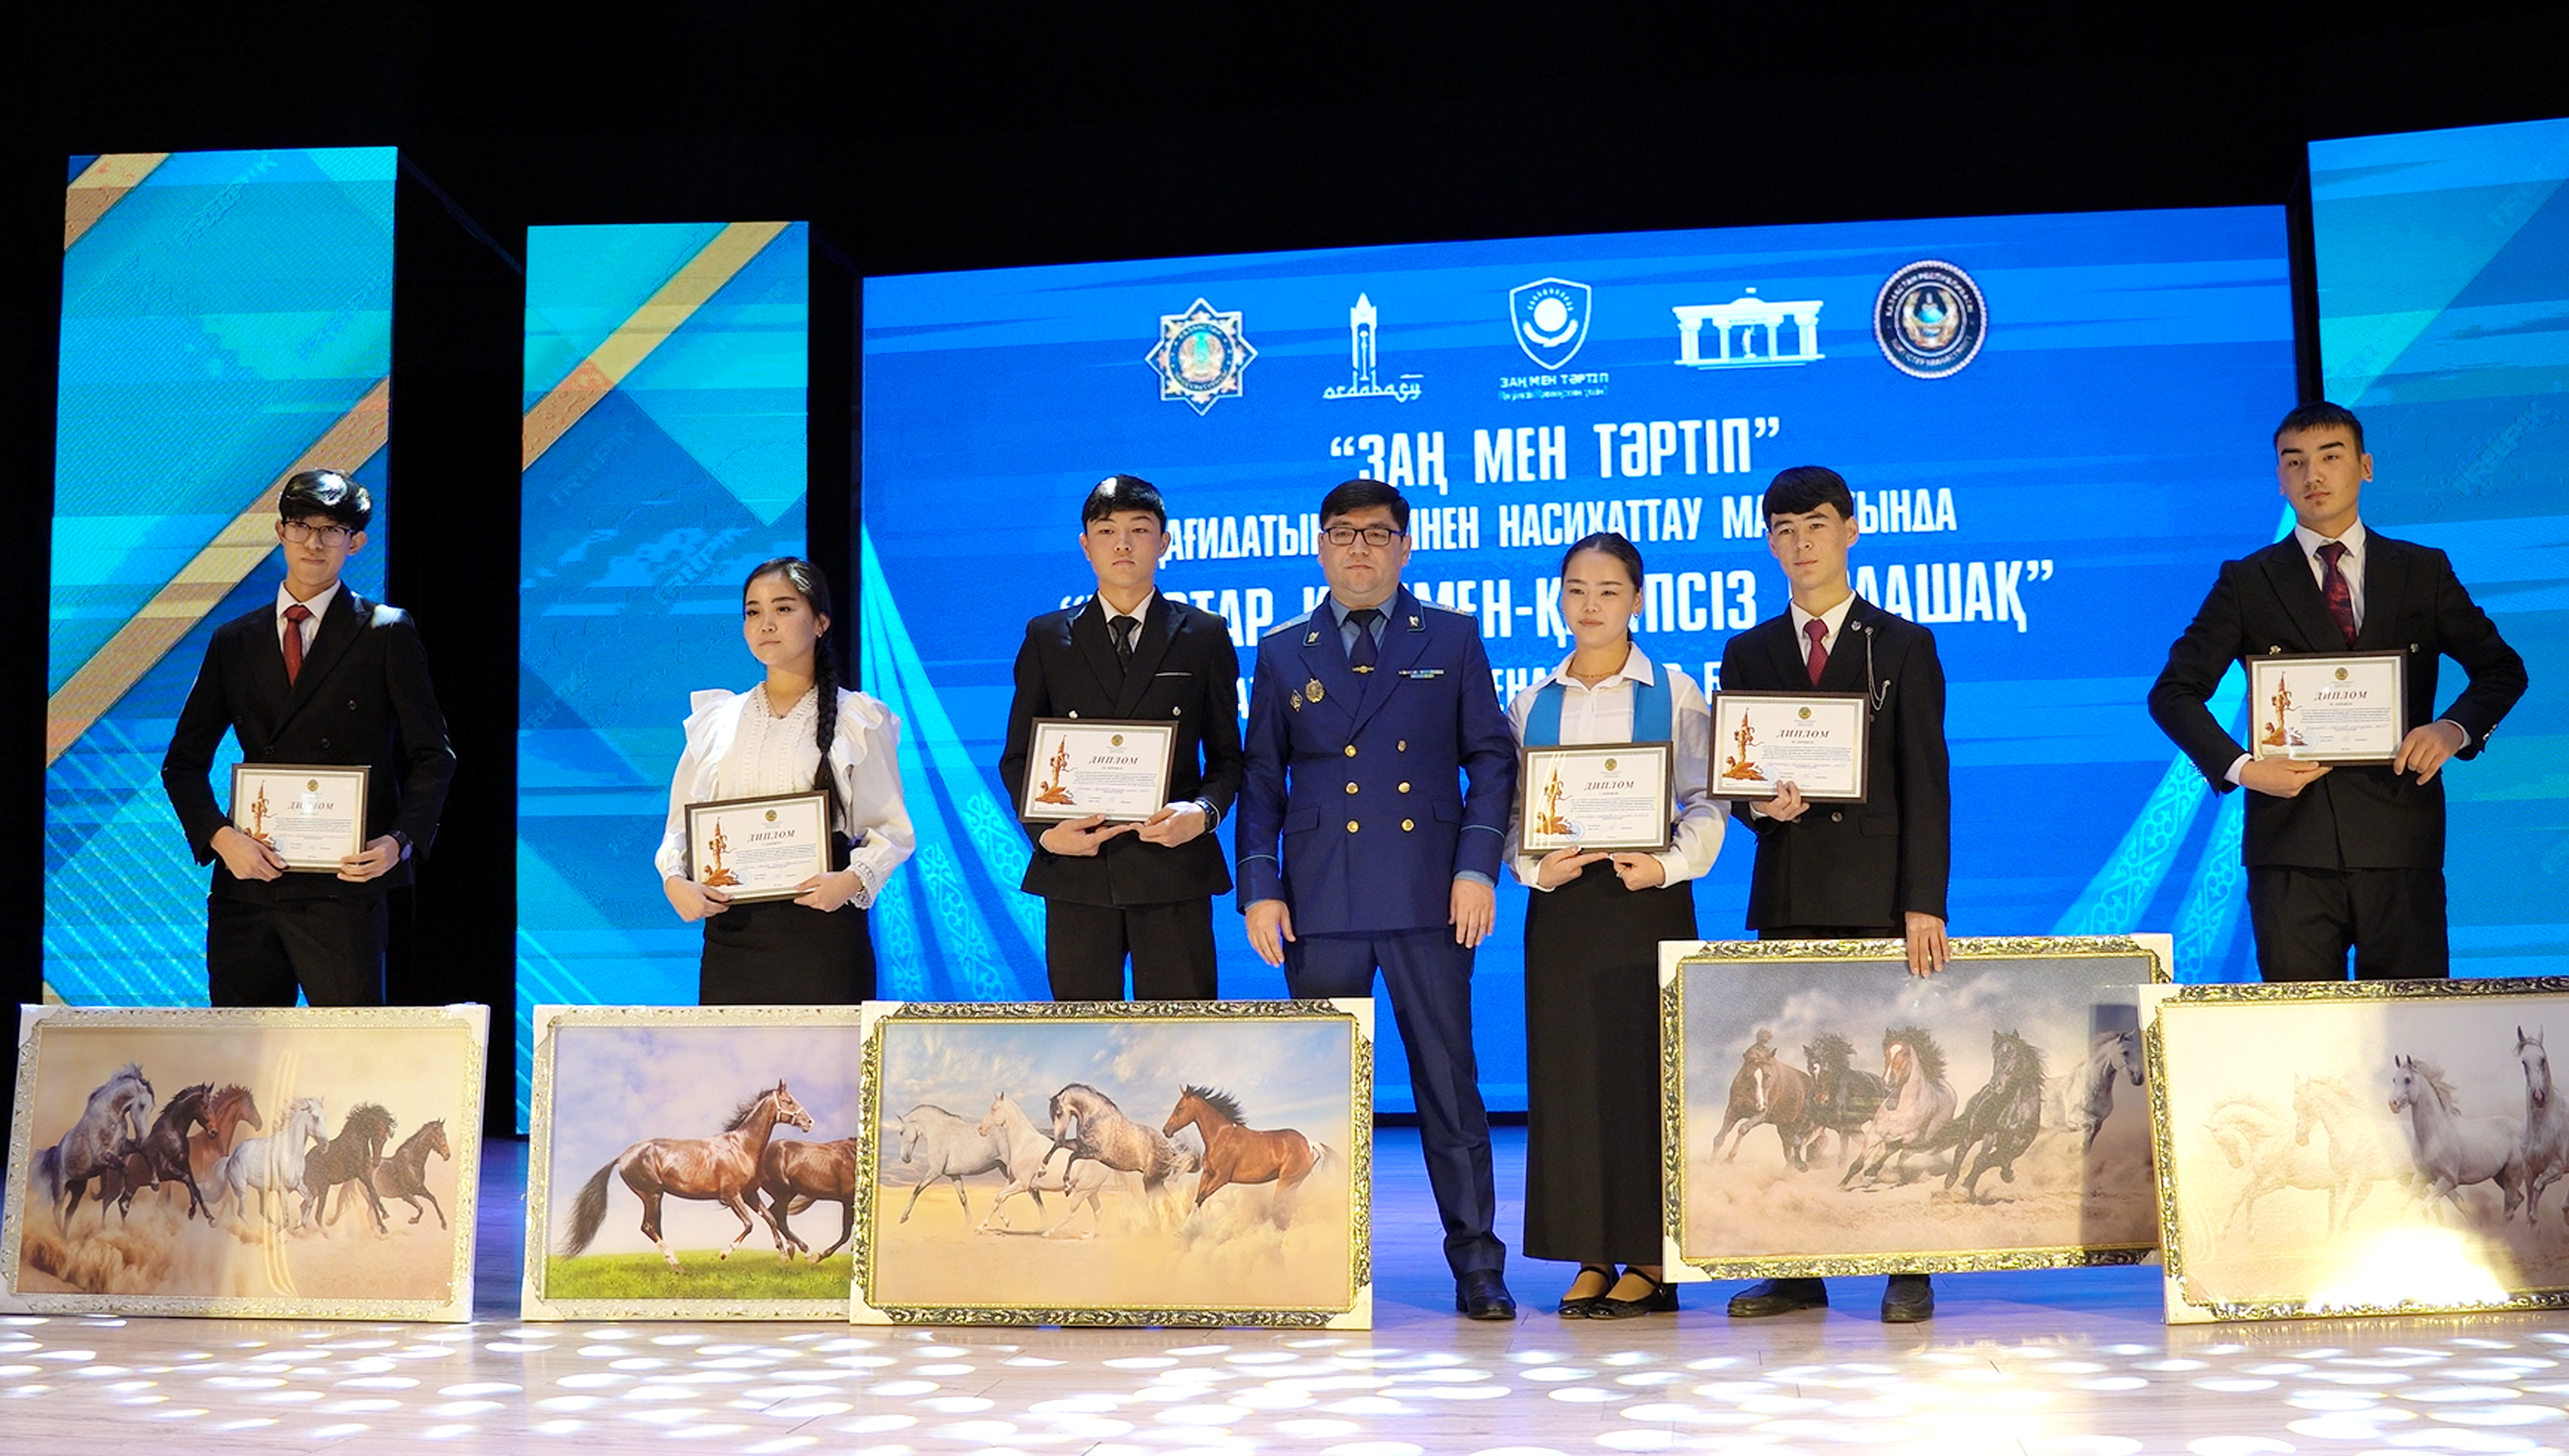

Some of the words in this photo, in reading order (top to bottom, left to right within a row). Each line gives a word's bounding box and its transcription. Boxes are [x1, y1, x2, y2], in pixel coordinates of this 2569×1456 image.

[1474, 426, 1567, 484] МЕН
[1159, 513, 1322, 569] АҒИДАТЫ
[1499, 497, 1703, 547] НАСИХАТТАУ
[2314, 691, 2368, 701] ДИПЛОМ
[1776, 729, 1829, 739] ДИПЛОМ
[1088, 755, 1139, 765] ДИПЛОМ
[1584, 780, 1635, 791] ДИПЛОМ
[287, 801, 334, 810] ДИЛОМ
[747, 830, 795, 843] ДИПЛОМ
